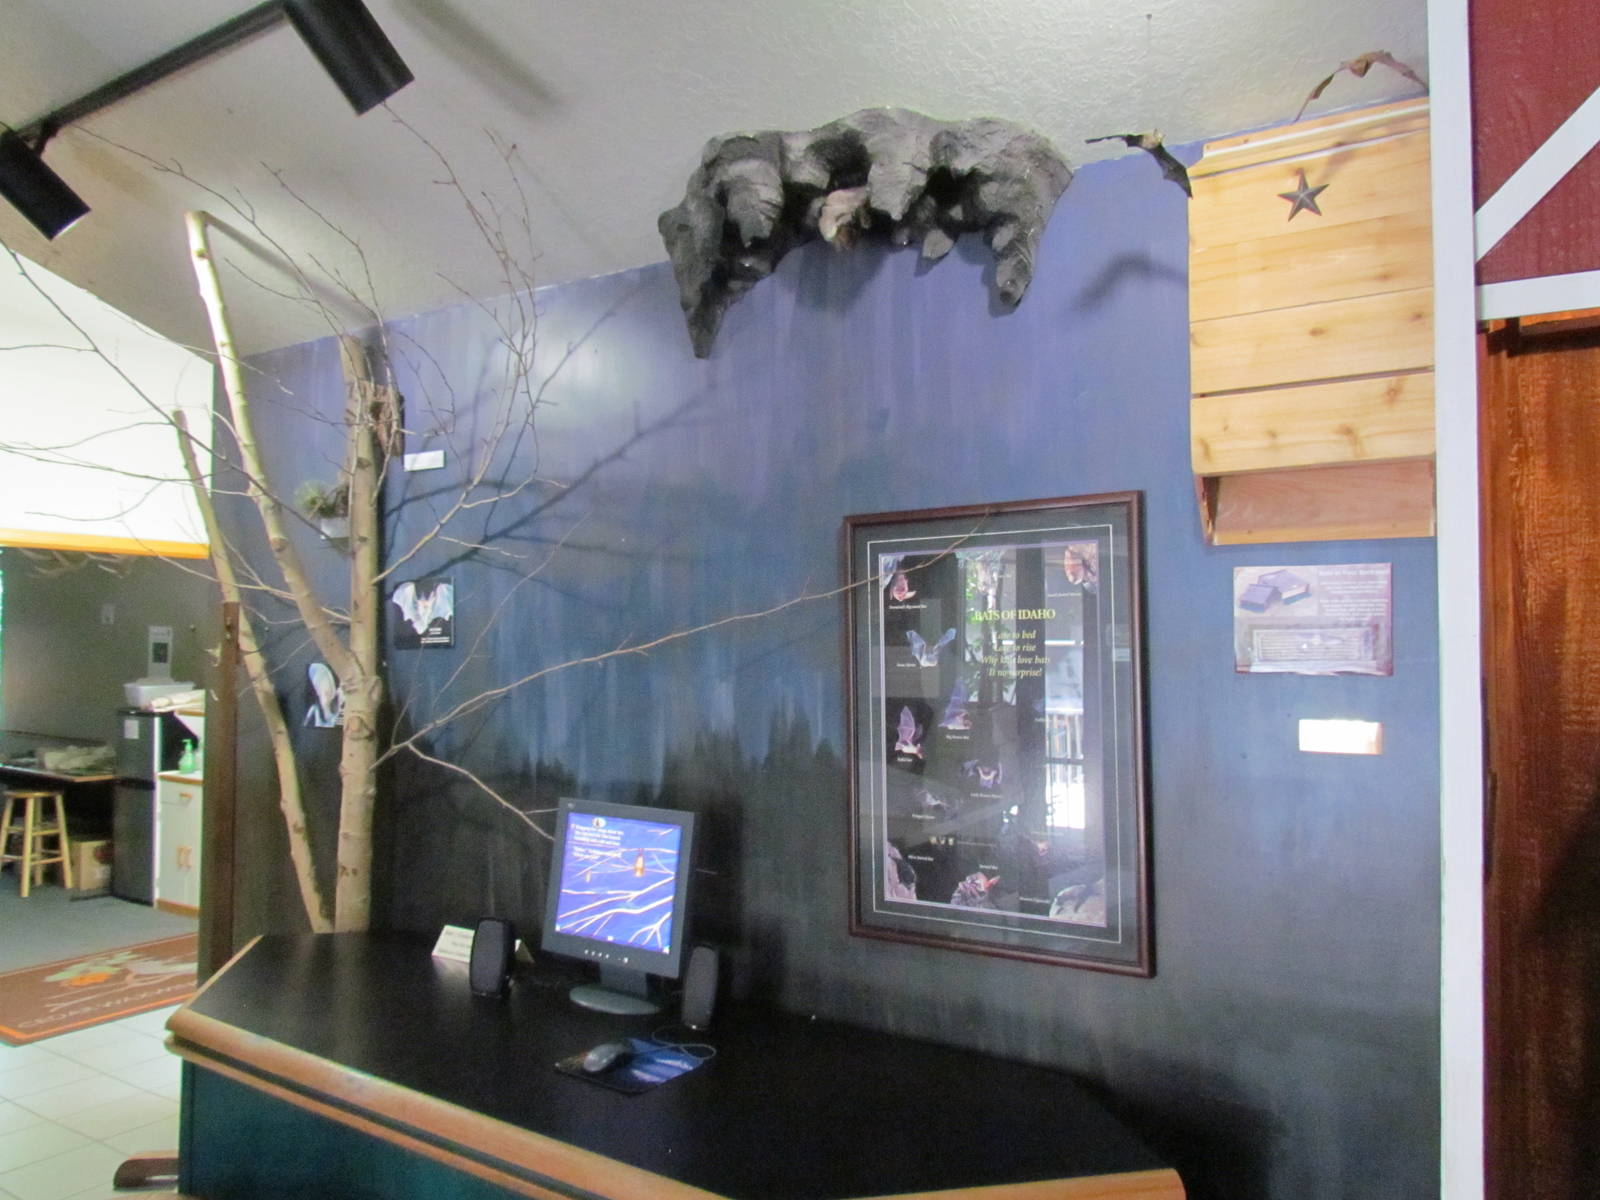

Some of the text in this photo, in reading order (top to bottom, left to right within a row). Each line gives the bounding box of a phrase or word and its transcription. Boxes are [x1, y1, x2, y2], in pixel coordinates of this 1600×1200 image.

[974, 608, 1056, 620] BATS OF IDAHO
[1021, 630, 1037, 639] bed
[1017, 655, 1034, 664] love
[1008, 668, 1042, 679] urprise!
